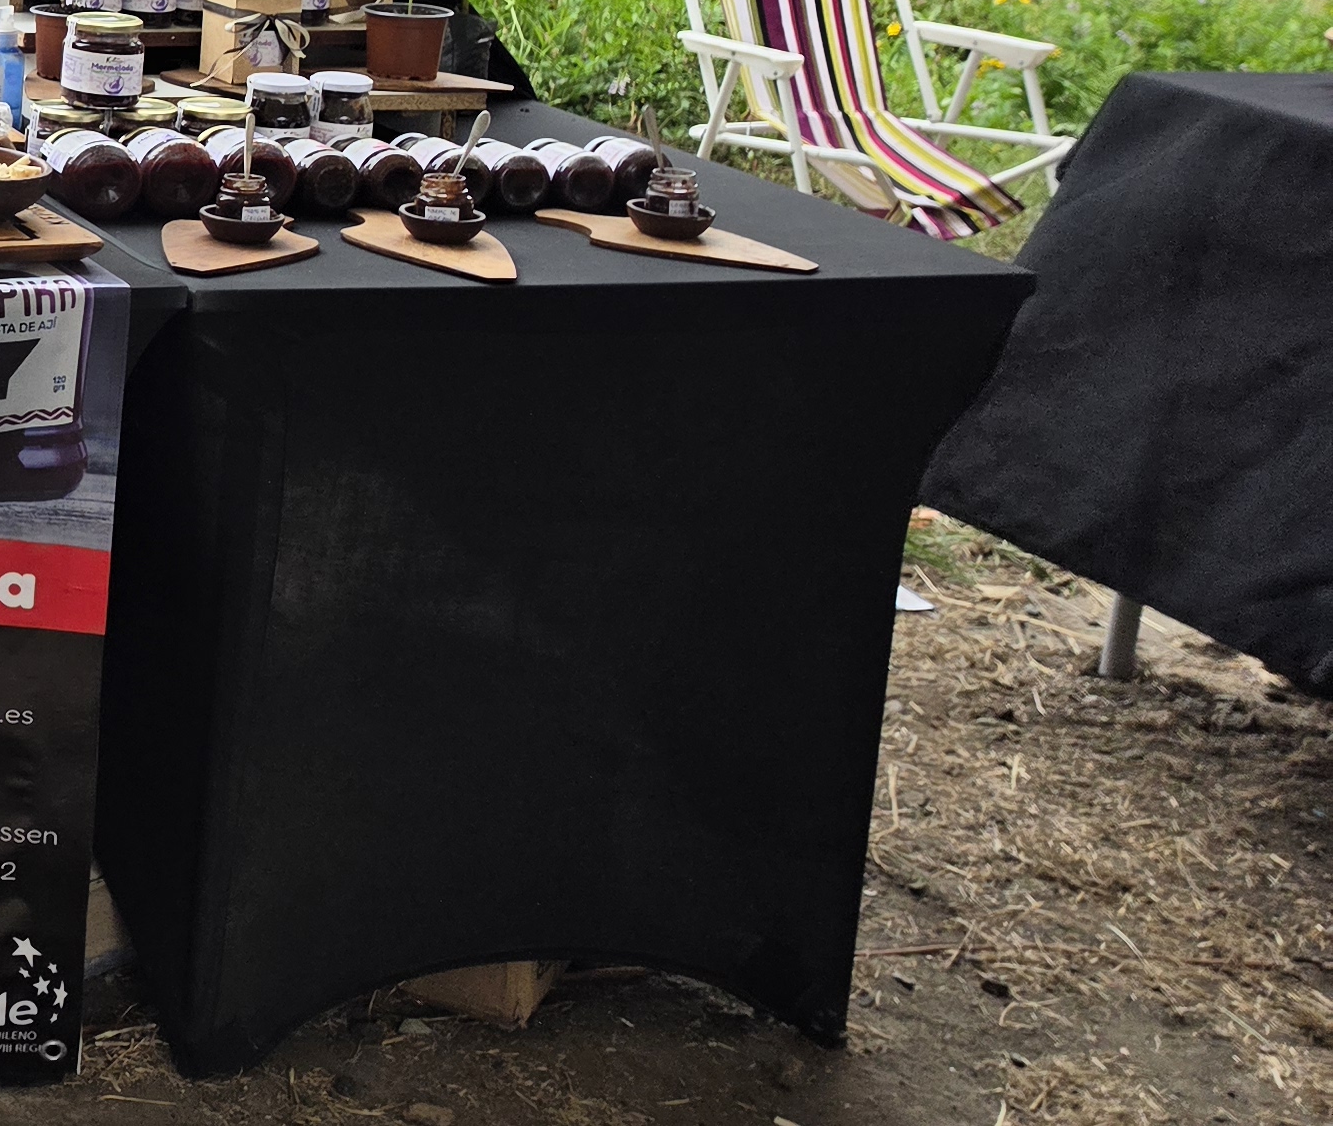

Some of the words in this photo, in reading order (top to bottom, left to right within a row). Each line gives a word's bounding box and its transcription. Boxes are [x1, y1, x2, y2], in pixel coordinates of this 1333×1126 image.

[19, 321, 36, 333] DE
[38, 316, 57, 331] AJÍ
[53, 375, 66, 384] 120
